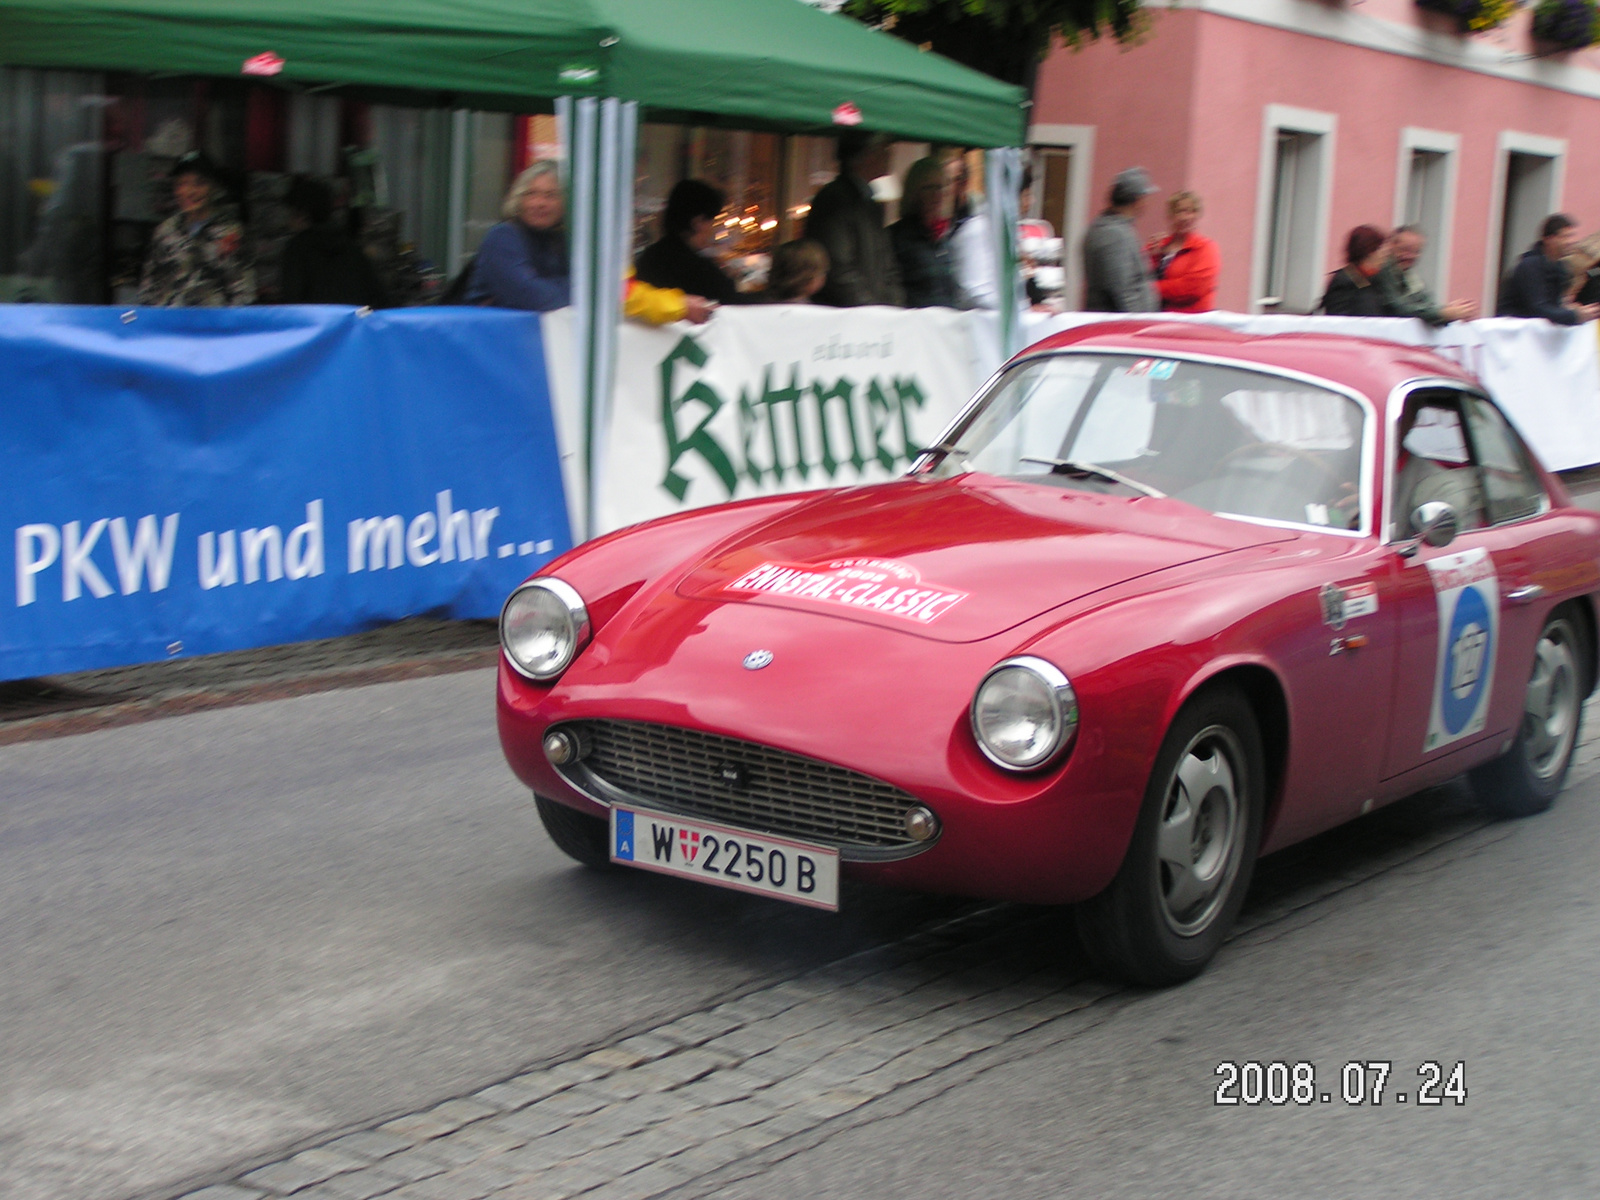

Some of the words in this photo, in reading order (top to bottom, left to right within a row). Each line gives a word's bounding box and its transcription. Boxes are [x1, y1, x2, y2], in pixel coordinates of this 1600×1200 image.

[813, 333, 894, 361] eduard
[659, 334, 928, 502] Kettner
[15, 512, 180, 607] PKW
[197, 498, 325, 591] und
[347, 489, 554, 575] mehr...
[732, 564, 959, 620] ENNSTAL-CLASSIC
[619, 840, 630, 853] A
[651, 823, 674, 863] W
[702, 835, 787, 888] 2250
[797, 855, 816, 894] B
